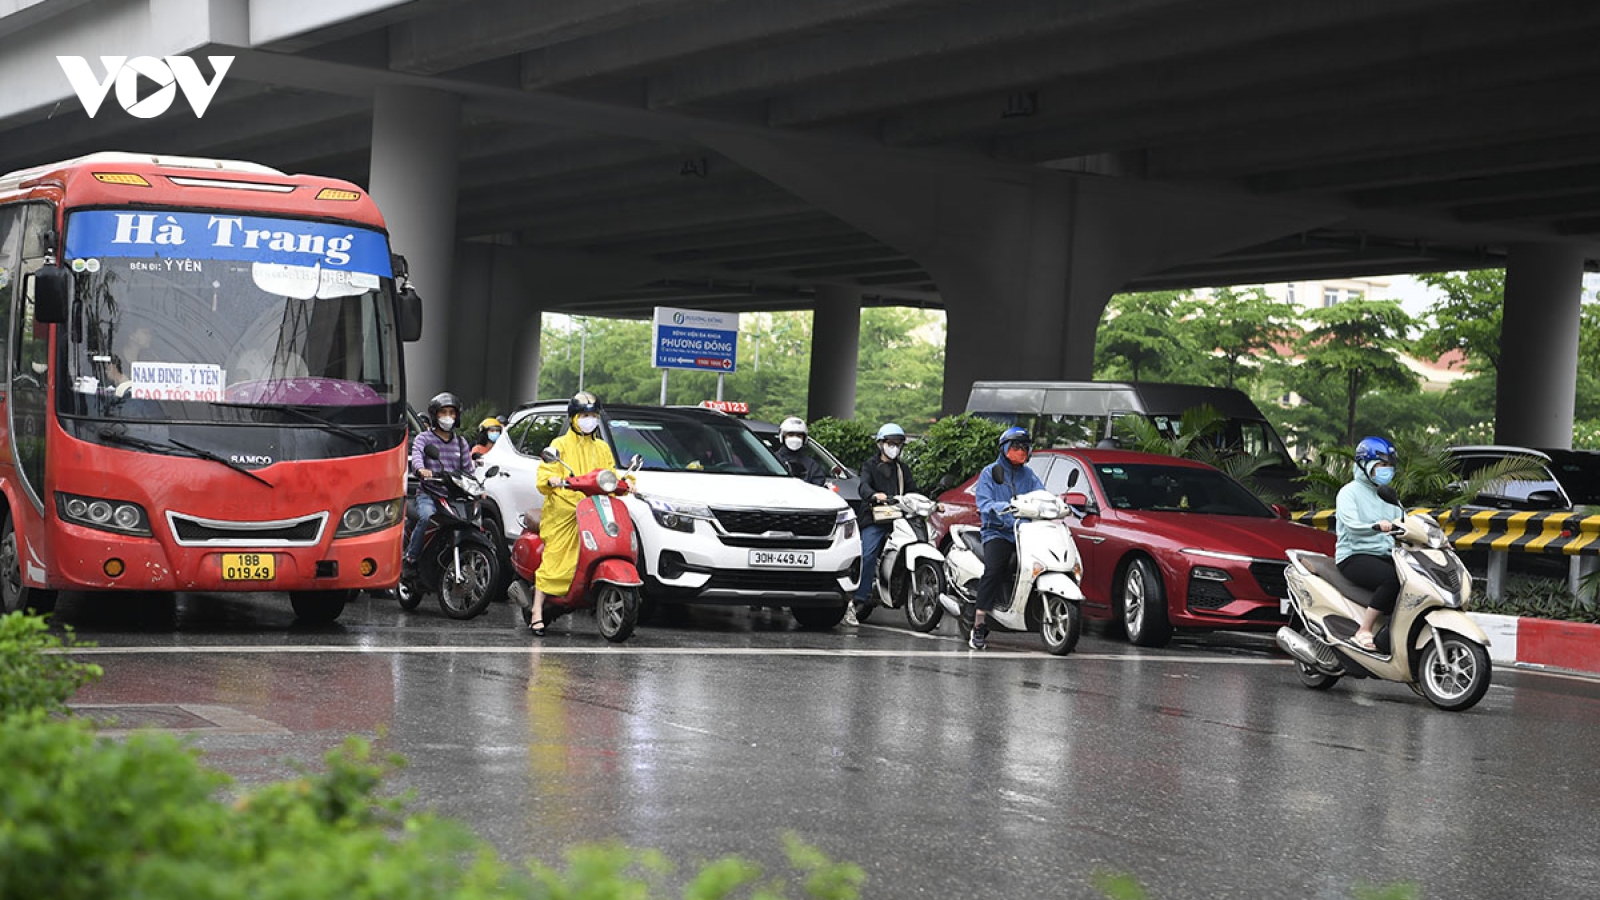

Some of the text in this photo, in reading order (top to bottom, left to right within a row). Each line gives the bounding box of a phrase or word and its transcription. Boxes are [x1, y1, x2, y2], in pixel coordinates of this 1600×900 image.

[112, 213, 354, 265] Hà Trang
[164, 257, 173, 271] Ý
[176, 258, 202, 272] YÊN
[661, 338, 702, 349] PHƯƠNG
[704, 340, 732, 352] ĐÔNG
[133, 366, 156, 383] NAM
[157, 367, 183, 387] ĐỊNH
[190, 365, 198, 385] Ý
[199, 365, 219, 385] YÊN
[134, 388, 162, 401] CAO
[165, 385, 191, 401] TỐC
[231, 455, 272, 465] SAMCO
[755, 552, 809, 565] 30H-449.42
[227, 567, 269, 579] 019.49
